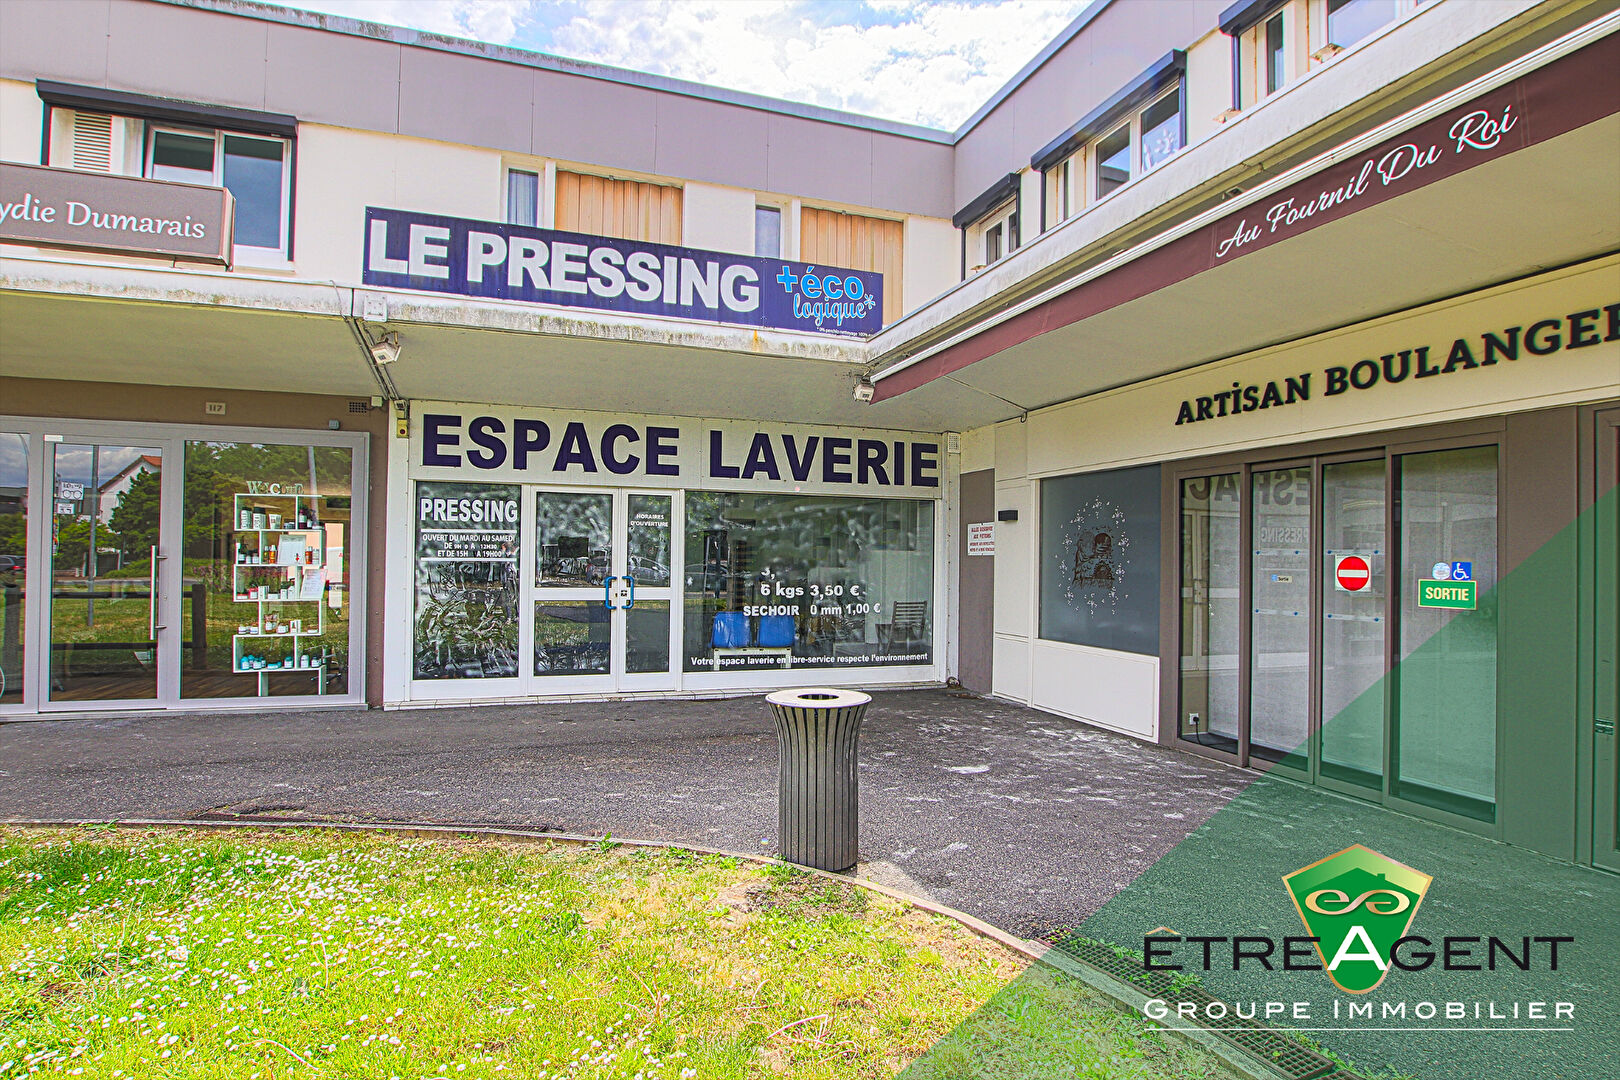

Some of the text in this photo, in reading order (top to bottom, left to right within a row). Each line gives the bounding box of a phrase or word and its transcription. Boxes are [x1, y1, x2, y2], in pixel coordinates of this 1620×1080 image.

[1216, 104, 1519, 258] Au Fournil Du Roi
[66, 201, 206, 239] Dumarais
[368, 218, 760, 313] LE PRESSING
[209, 404, 223, 412] 117
[419, 413, 939, 488] ESPACE LAVERIE
[420, 498, 518, 522] PRESSING
[422, 534, 448, 542] OUVERT
[449, 534, 459, 542] DU
[460, 534, 480, 542] MARDI
[775, 581, 804, 599] kgs
[809, 585, 844, 600] 3,50
[850, 585, 860, 596] €
[1425, 587, 1470, 601] SORTIE
[743, 605, 800, 616] SECHOIR
[846, 603, 870, 615] 1,00
[873, 603, 881, 613] €
[691, 656, 713, 666] Votre
[714, 658, 745, 667] espace
[747, 655, 775, 665] laverie
[788, 654, 835, 664] libre-service
[836, 655, 869, 665] respecte
[871, 652, 928, 662] l'environnement
